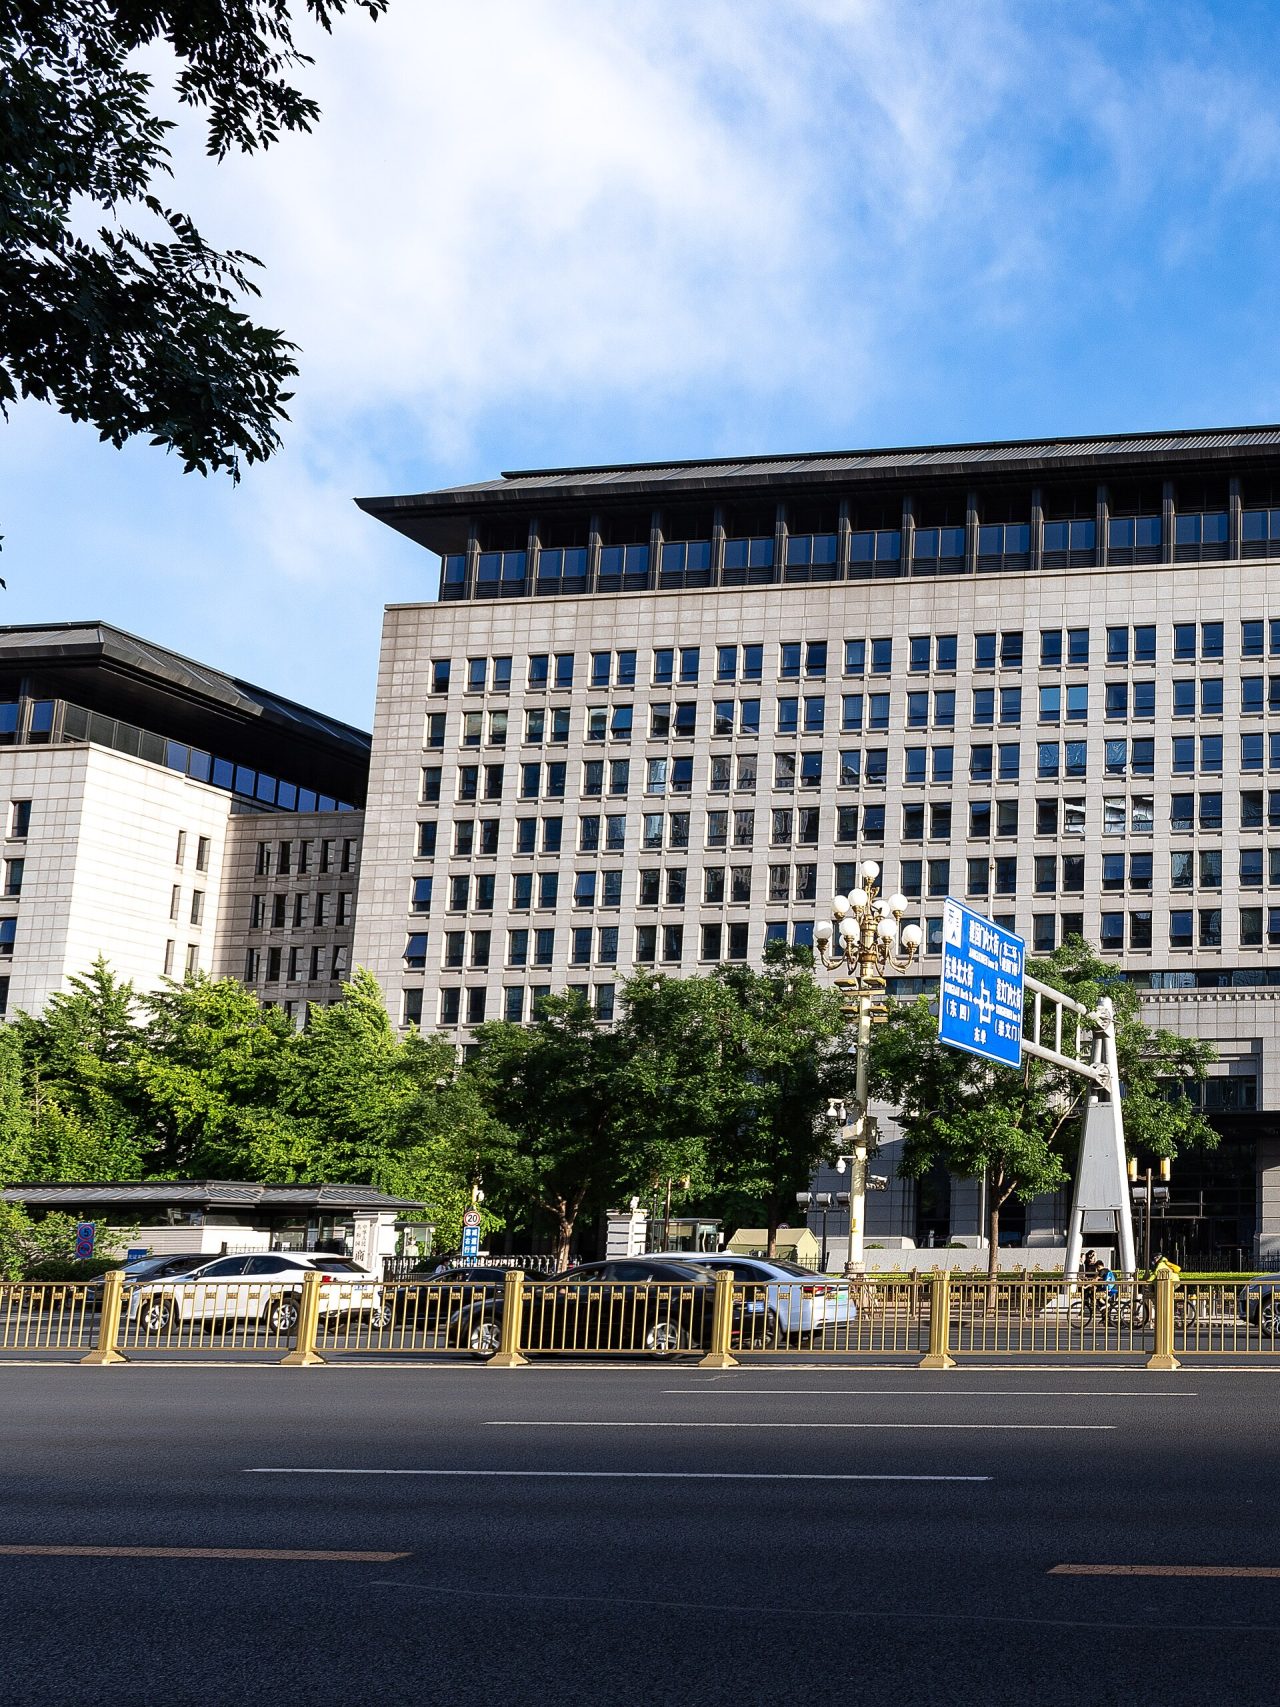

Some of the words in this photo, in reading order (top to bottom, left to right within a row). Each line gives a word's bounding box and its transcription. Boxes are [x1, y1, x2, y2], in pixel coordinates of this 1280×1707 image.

[945, 954, 974, 988] 东单北大街
[996, 977, 1021, 1010] 崇文门内大街
[974, 1027, 987, 1045] 东单
[467, 1214, 477, 1222] 20
